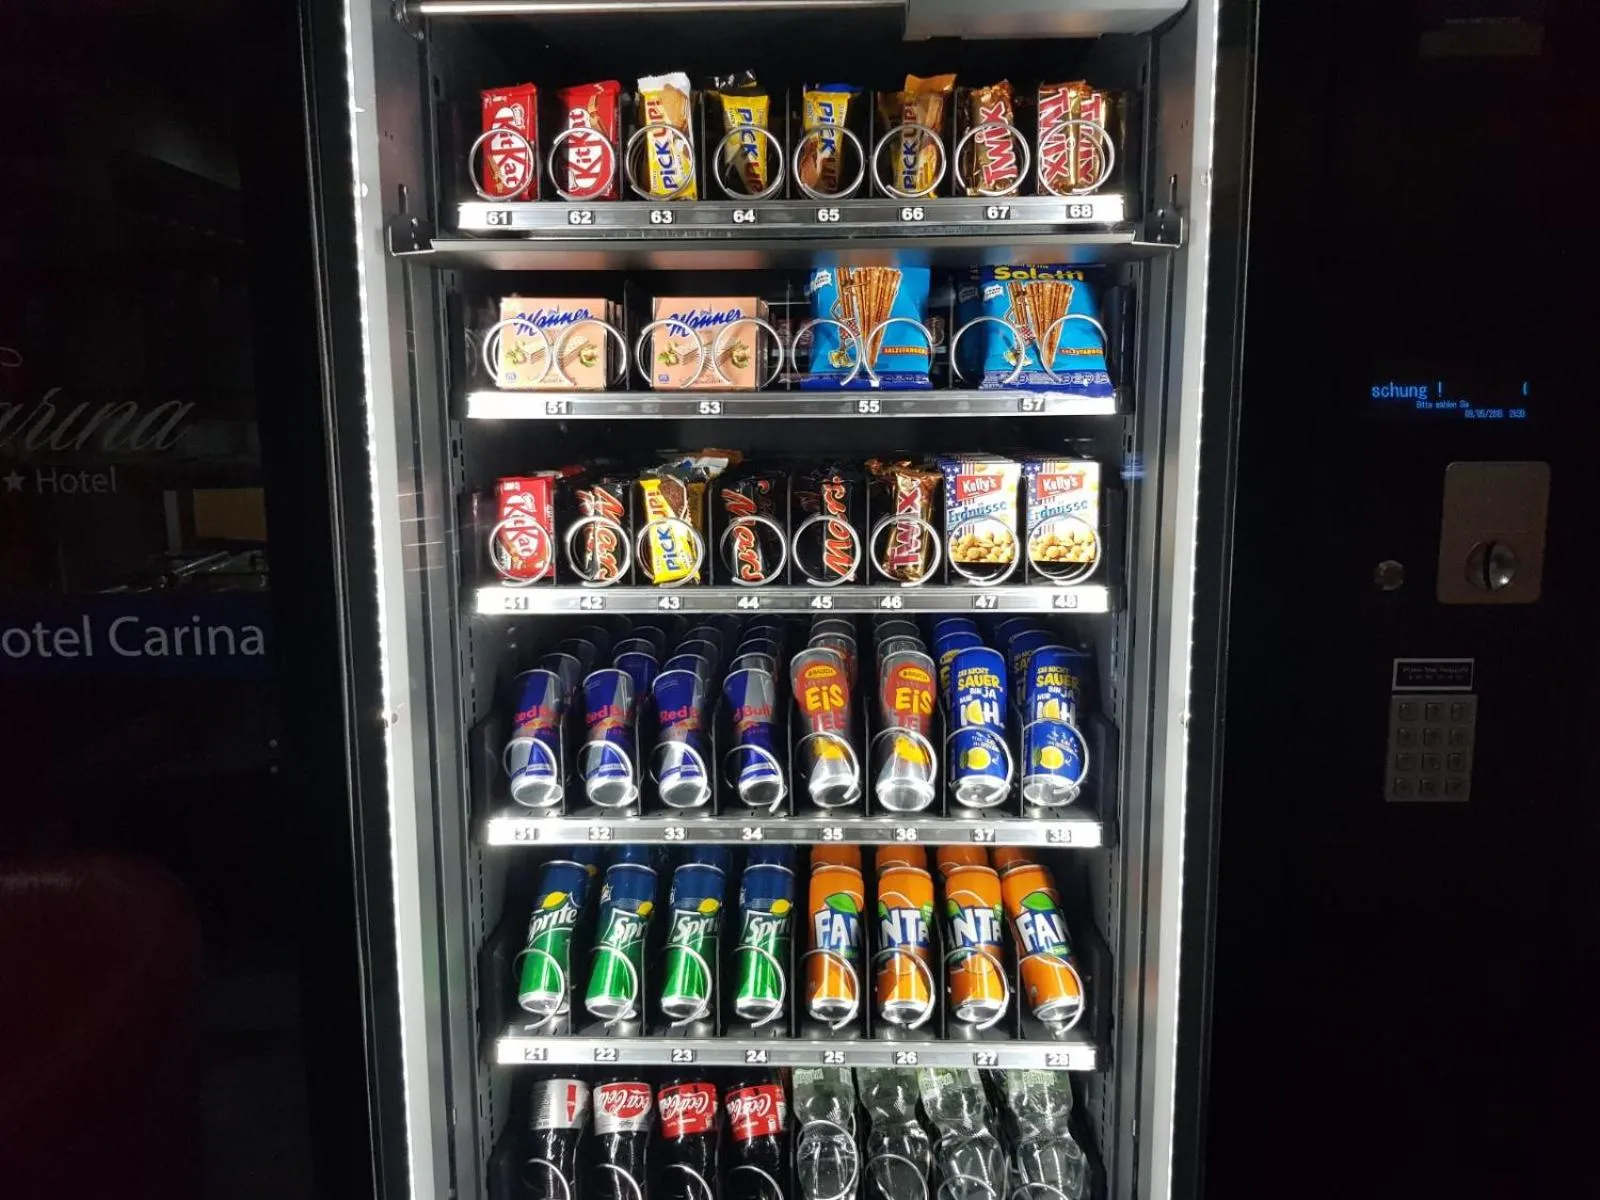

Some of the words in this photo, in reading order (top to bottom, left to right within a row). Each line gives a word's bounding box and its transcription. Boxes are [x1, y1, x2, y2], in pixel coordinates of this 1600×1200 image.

[487, 211, 508, 224] 61
[570, 211, 592, 224] 62
[651, 211, 673, 223] 63
[733, 210, 755, 223] 64
[818, 209, 840, 222] 65
[901, 208, 924, 221] 66
[987, 207, 1010, 220] 67
[1069, 205, 1093, 218] 68
[666, 308, 746, 337] Manner
[1371, 381, 1428, 400] schung
[547, 401, 567, 414] 51
[700, 401, 721, 414] 53
[858, 400, 880, 413] 55
[1022, 398, 1045, 411] 57
[37, 466, 117, 494] Hotel
[961, 476, 997, 494] Kelly's
[1042, 475, 1079, 494] Kelly's
[948, 501, 1008, 523] Erdnüsse
[1028, 500, 1088, 522] Erdnüsse
[890, 488, 921, 571] TWX
[580, 597, 603, 609] 42
[659, 597, 680, 608] 43
[737, 597, 759, 608] 44
[811, 596, 833, 608] 45
[881, 596, 902, 608] 46
[975, 596, 998, 608] 47
[108, 615, 266, 658] Carina
[981, 687, 997, 700] JA
[590, 828, 611, 840] 32
[665, 828, 685, 839] 33
[742, 828, 762, 839] 34
[822, 828, 843, 840] 35
[896, 828, 917, 840] 36
[974, 829, 995, 841] 37
[1049, 829, 1071, 842] 38
[878, 908, 930, 949] NTA
[525, 1049, 545, 1060] 21
[596, 1049, 617, 1061] 22
[673, 1049, 692, 1061] 23
[746, 1050, 767, 1062] 24
[824, 1051, 845, 1063] 25
[896, 1052, 917, 1064] 26
[977, 1052, 997, 1065] 27
[1049, 1054, 1069, 1066] 28
